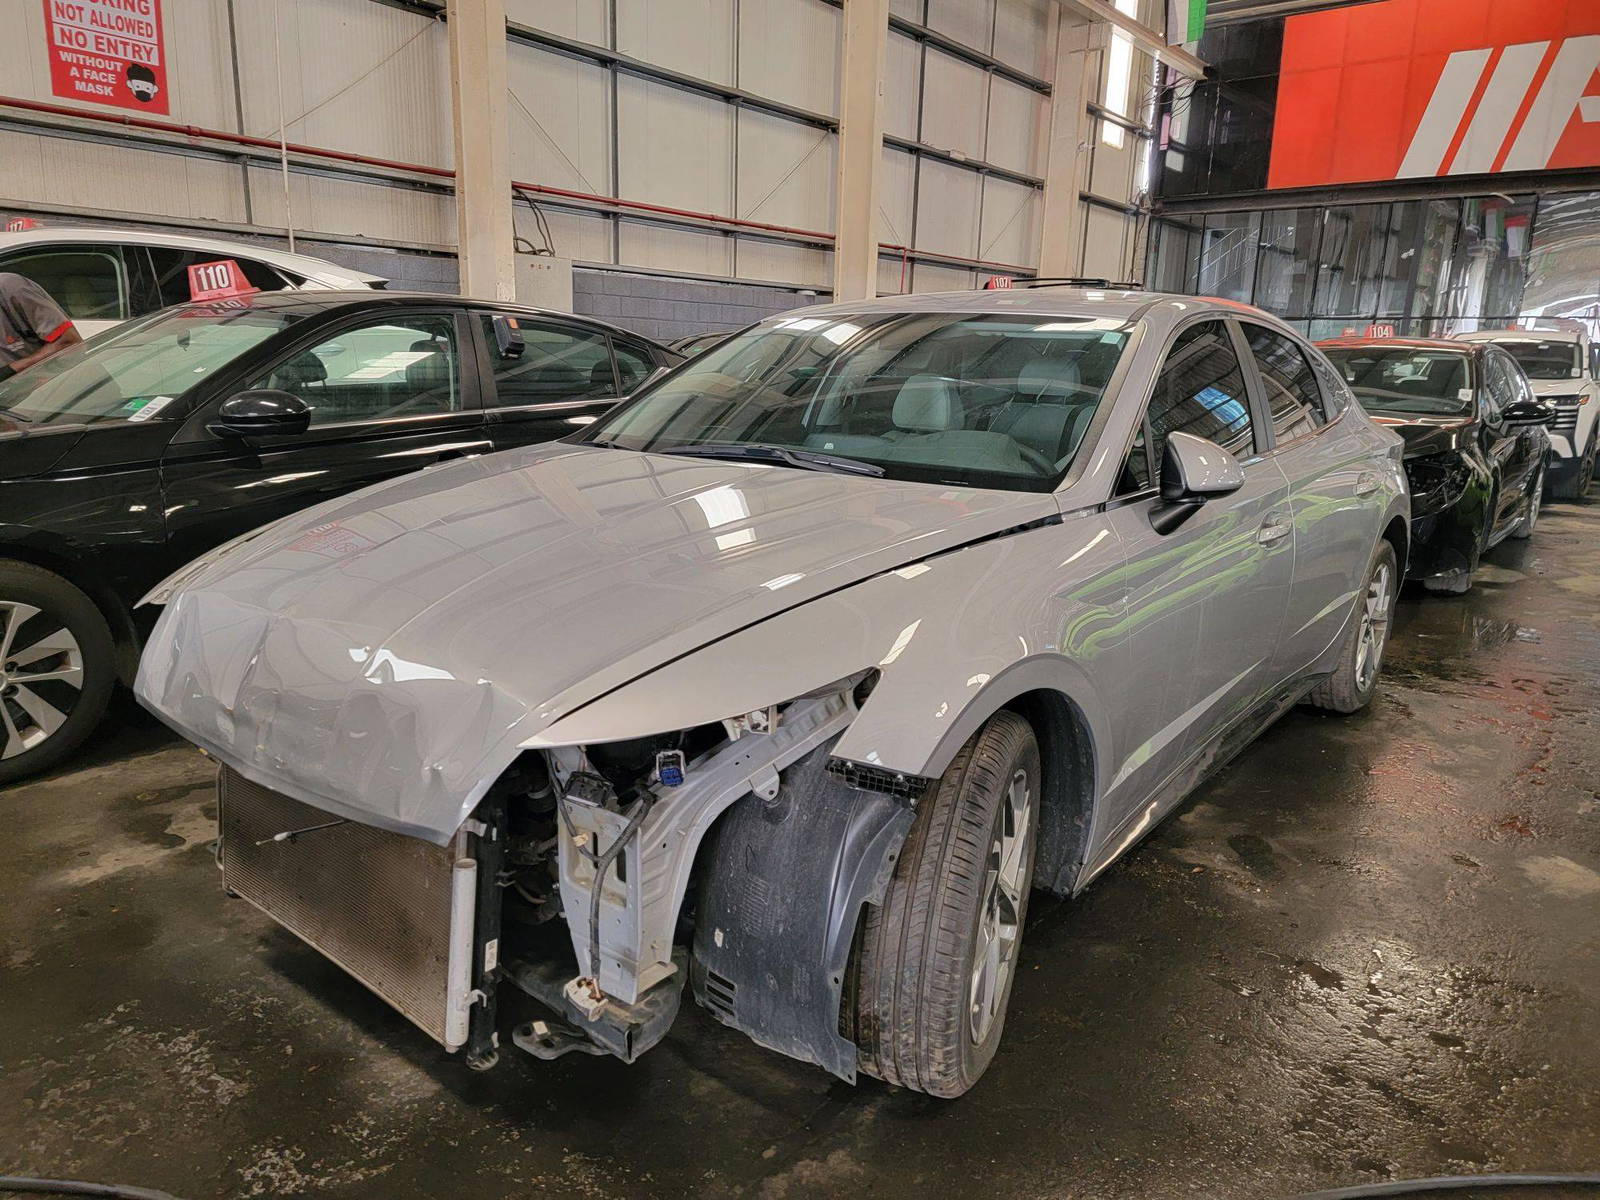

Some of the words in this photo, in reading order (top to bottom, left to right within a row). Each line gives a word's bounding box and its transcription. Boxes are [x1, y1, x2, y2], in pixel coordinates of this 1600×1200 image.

[55, 1, 84, 23] NOT
[90, 9, 153, 38] ALLOWED
[59, 28, 87, 48] NO
[94, 35, 154, 62] ENTRY
[59, 51, 123, 72] WITHOUT
[70, 67, 80, 77] A
[82, 69, 117, 84] FACE
[75, 81, 114, 97] MASK
[198, 264, 229, 291] 110
[995, 277, 1008, 288] 107
[1372, 326, 1389, 338] 104
